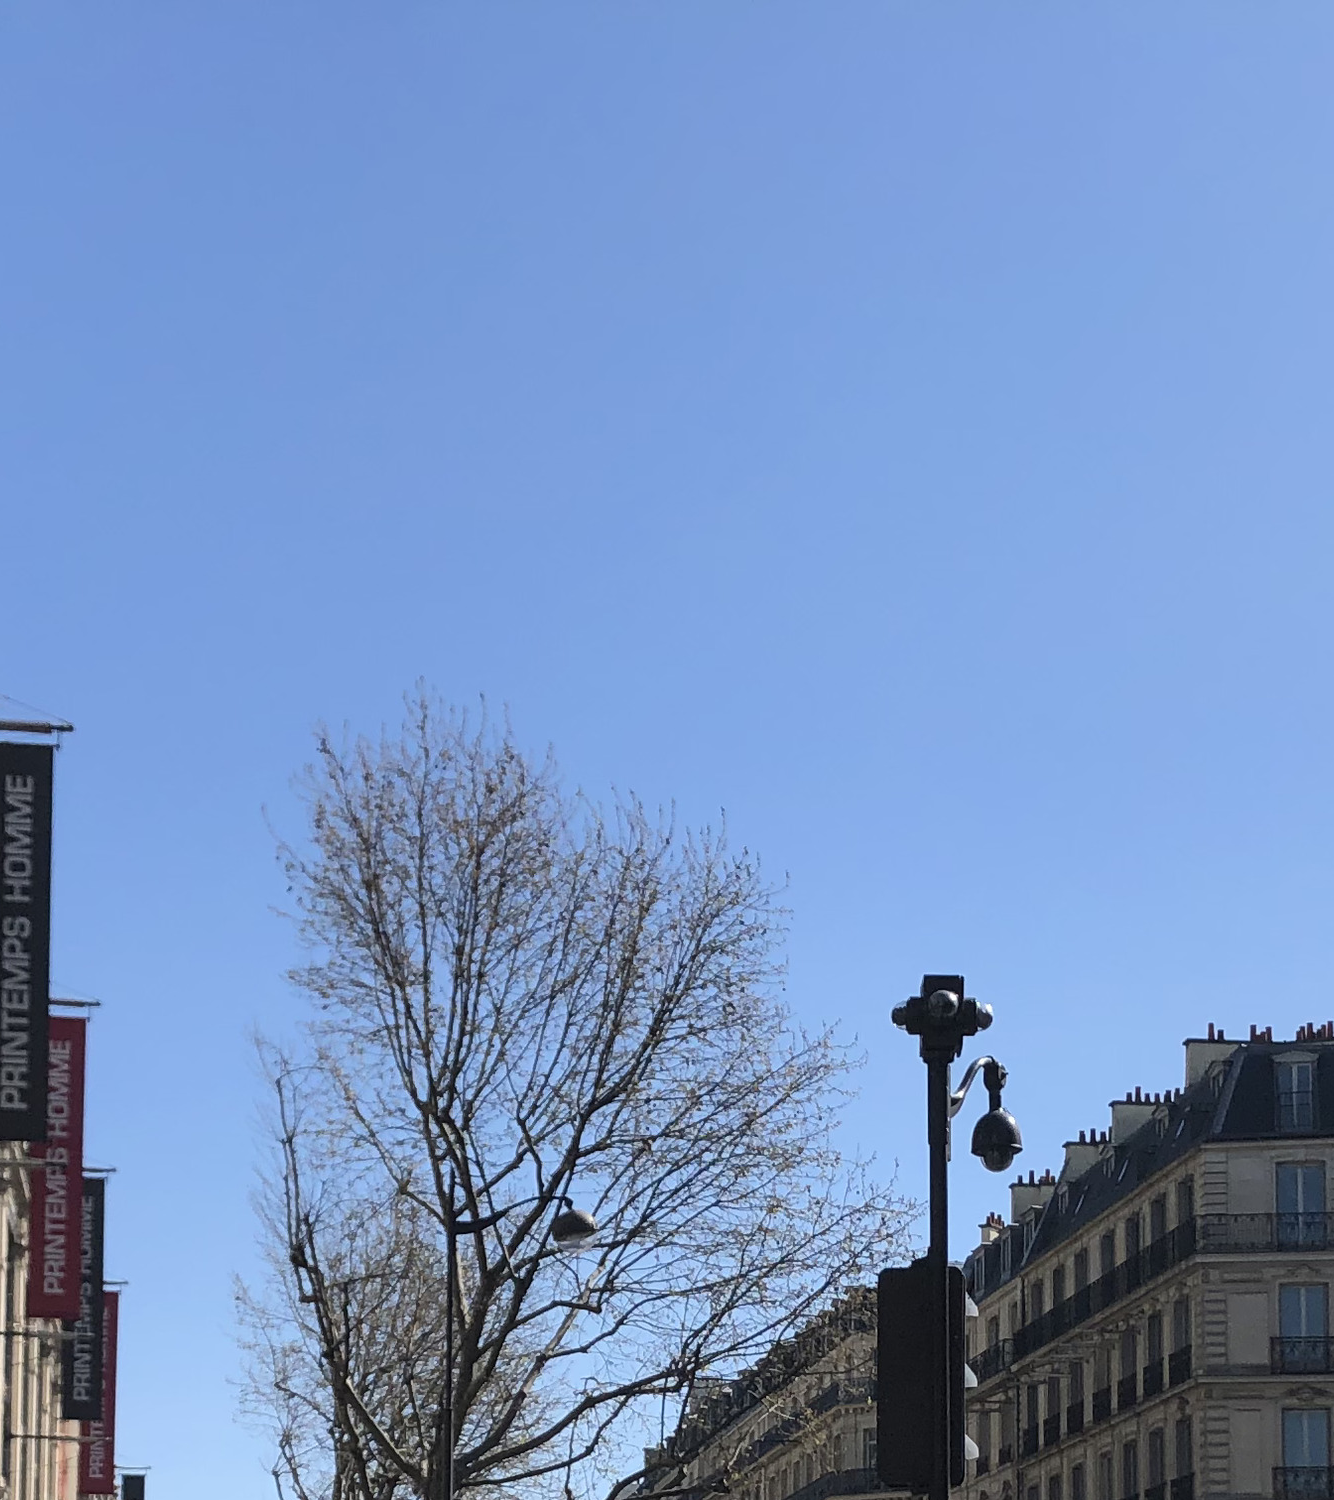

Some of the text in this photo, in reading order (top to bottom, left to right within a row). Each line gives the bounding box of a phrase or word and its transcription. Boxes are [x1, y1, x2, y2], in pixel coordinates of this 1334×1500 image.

[0, 773, 35, 1111] PRINTEMPS HOMME
[43, 1039, 72, 1297] PRINTEMPS HOMME
